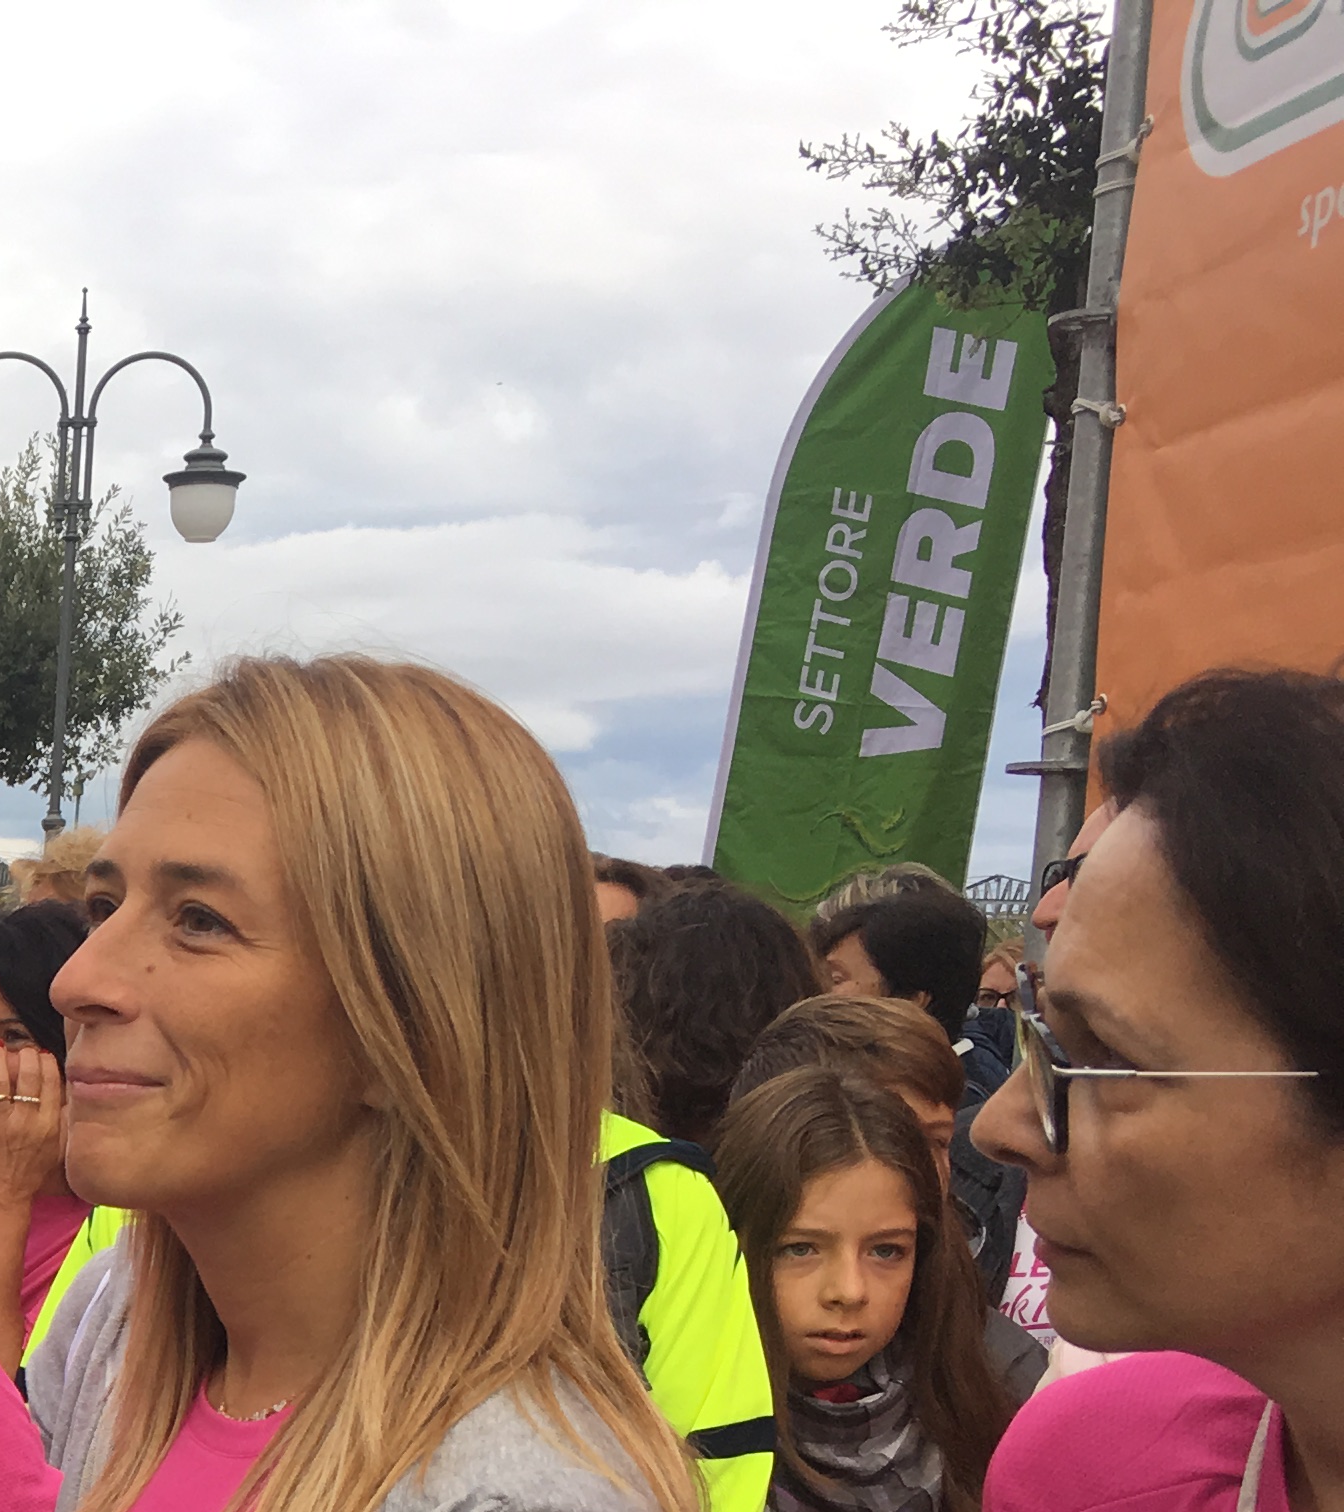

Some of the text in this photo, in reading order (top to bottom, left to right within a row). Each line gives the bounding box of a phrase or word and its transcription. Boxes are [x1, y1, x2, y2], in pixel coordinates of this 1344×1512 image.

[1296, 180, 1344, 250] sp
[793, 487, 873, 735] SETTORE
[859, 326, 1018, 758] VERDE
